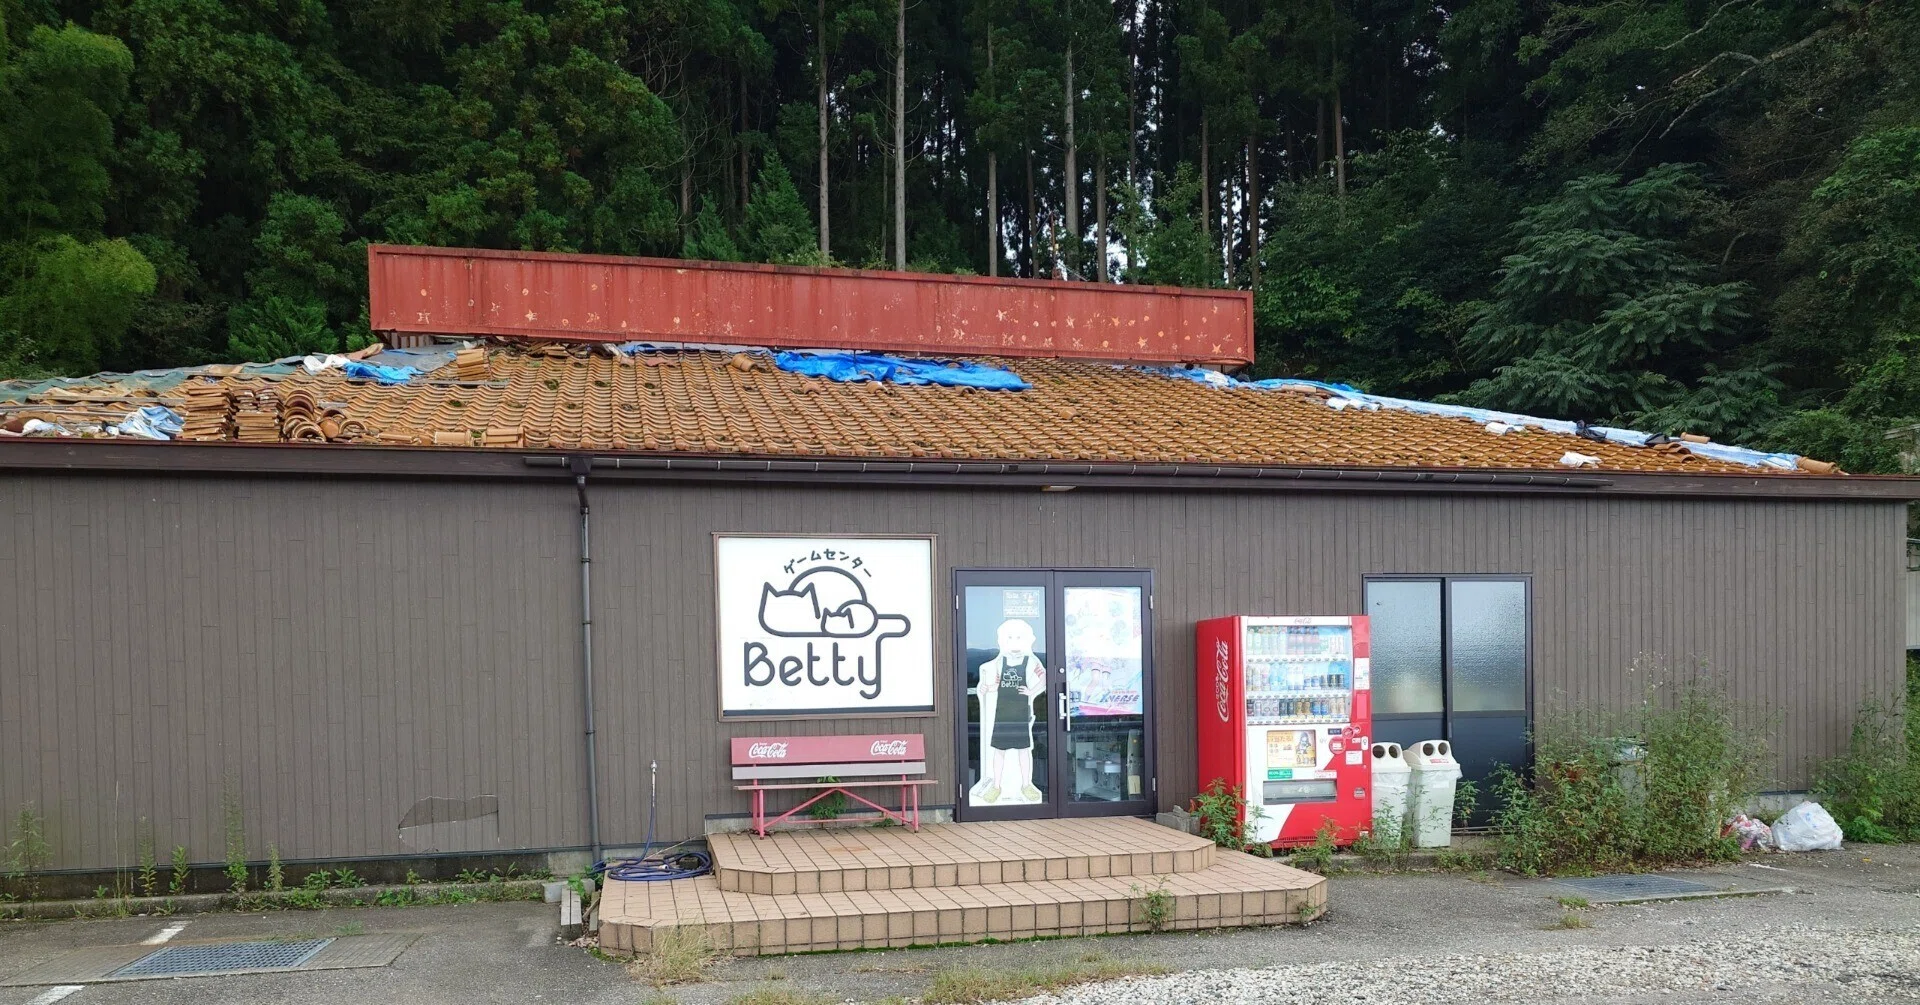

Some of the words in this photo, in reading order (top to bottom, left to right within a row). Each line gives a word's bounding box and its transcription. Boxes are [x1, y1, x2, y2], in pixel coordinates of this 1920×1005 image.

[783, 548, 872, 578] ゲームセンター
[743, 641, 882, 700] Betty
